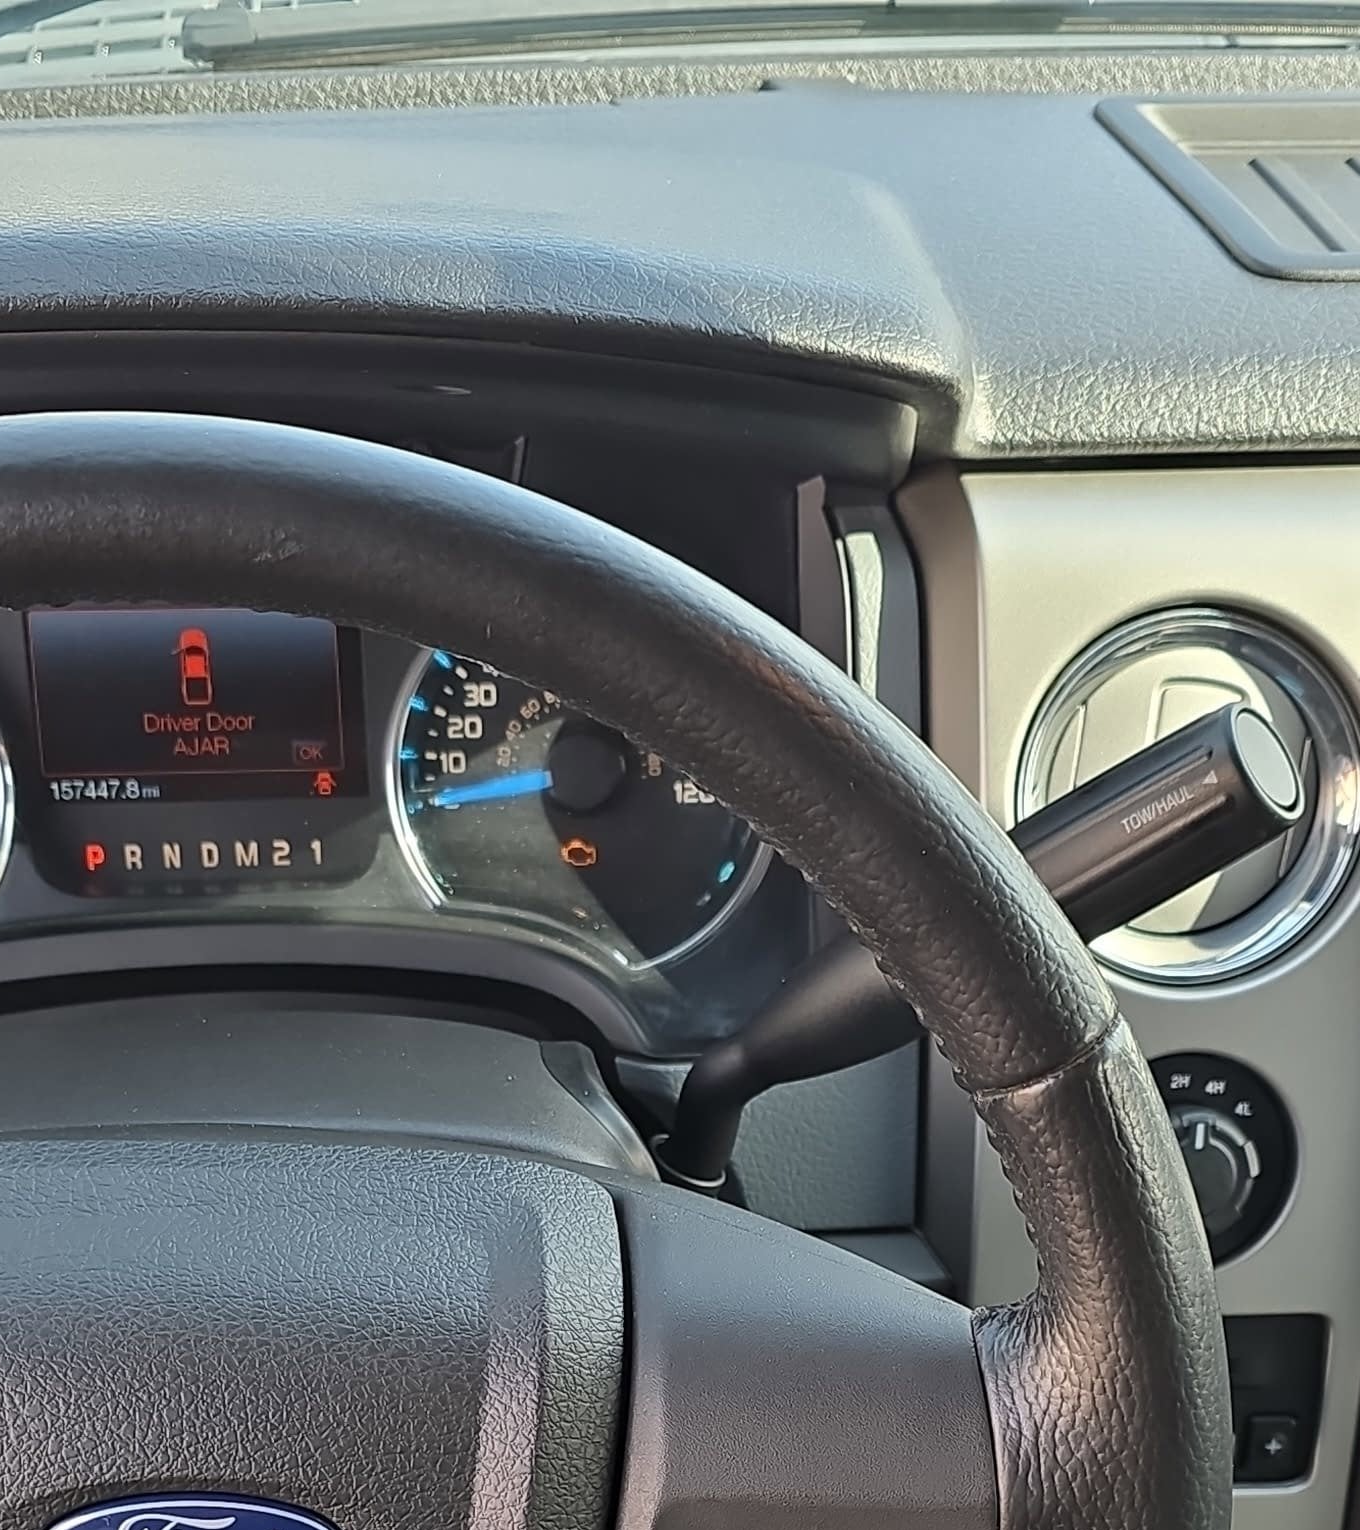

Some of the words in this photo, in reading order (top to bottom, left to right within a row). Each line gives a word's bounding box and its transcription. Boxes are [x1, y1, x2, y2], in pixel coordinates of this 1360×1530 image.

[464, 682, 497, 706] 30
[144, 714, 199, 733] Driver
[206, 713, 255, 731] Door
[447, 715, 482, 739] 20
[173, 736, 230, 757] AJAR
[300, 746, 324, 760] OK
[439, 751, 466, 774] 10
[50, 780, 140, 801] 157447.8
[1120, 783, 1195, 834] TOW/HAUL
[87, 845, 104, 870] P
[125, 844, 143, 870] R
[163, 844, 181, 869] N
[201, 843, 219, 868] D
[236, 841, 259, 866] M
[272, 840, 291, 866] 2
[311, 840, 322, 865] 1
[1170, 1073, 1191, 1089] 2H
[1205, 1079, 1227, 1095] 4H
